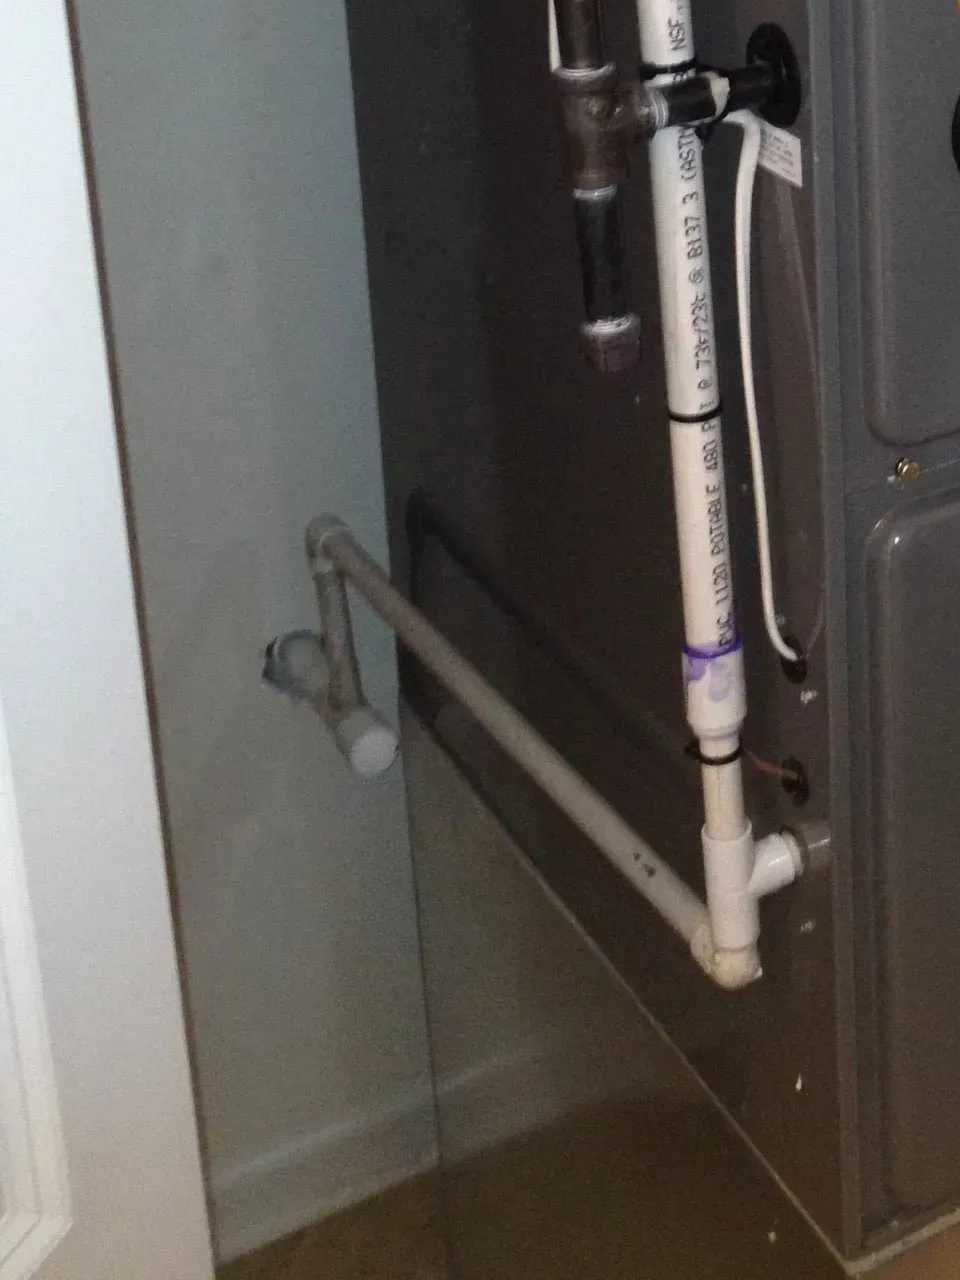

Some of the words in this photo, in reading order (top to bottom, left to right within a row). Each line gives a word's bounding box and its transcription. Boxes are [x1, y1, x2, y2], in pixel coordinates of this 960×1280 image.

[667, 17, 688, 52] NSF
[703, 439, 719, 471] 480
[706, 483, 727, 557] POTABLE
[712, 561, 732, 606] 1120
